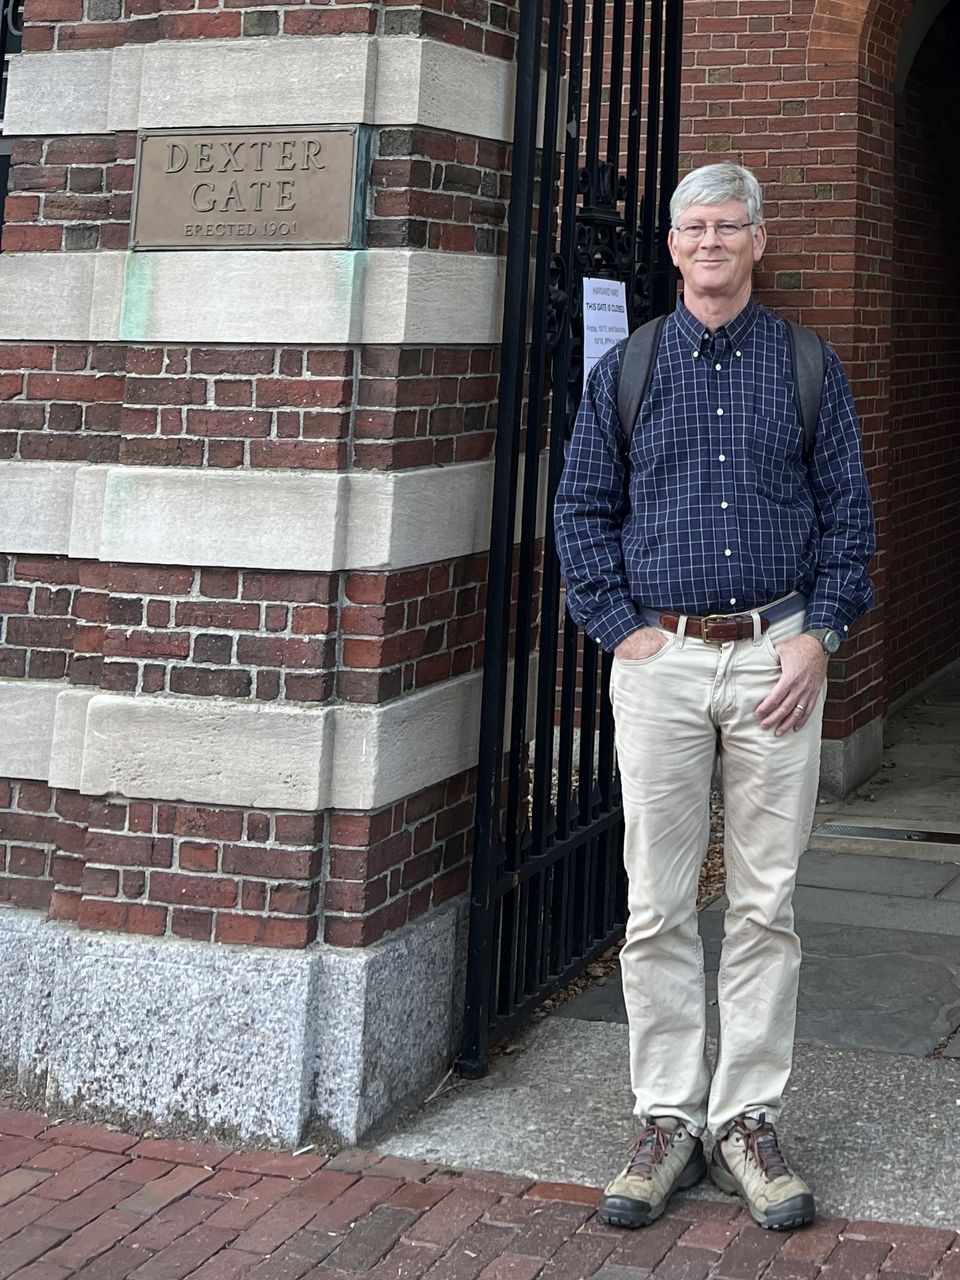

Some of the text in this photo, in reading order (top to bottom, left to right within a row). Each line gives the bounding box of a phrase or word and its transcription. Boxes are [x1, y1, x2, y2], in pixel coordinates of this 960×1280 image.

[165, 139, 325, 173] DEXTER
[190, 179, 297, 213] GATE
[183, 221, 298, 237] ERECTED 1901
[586, 302, 596, 311] THIS
[597, 303, 607, 312] GATE
